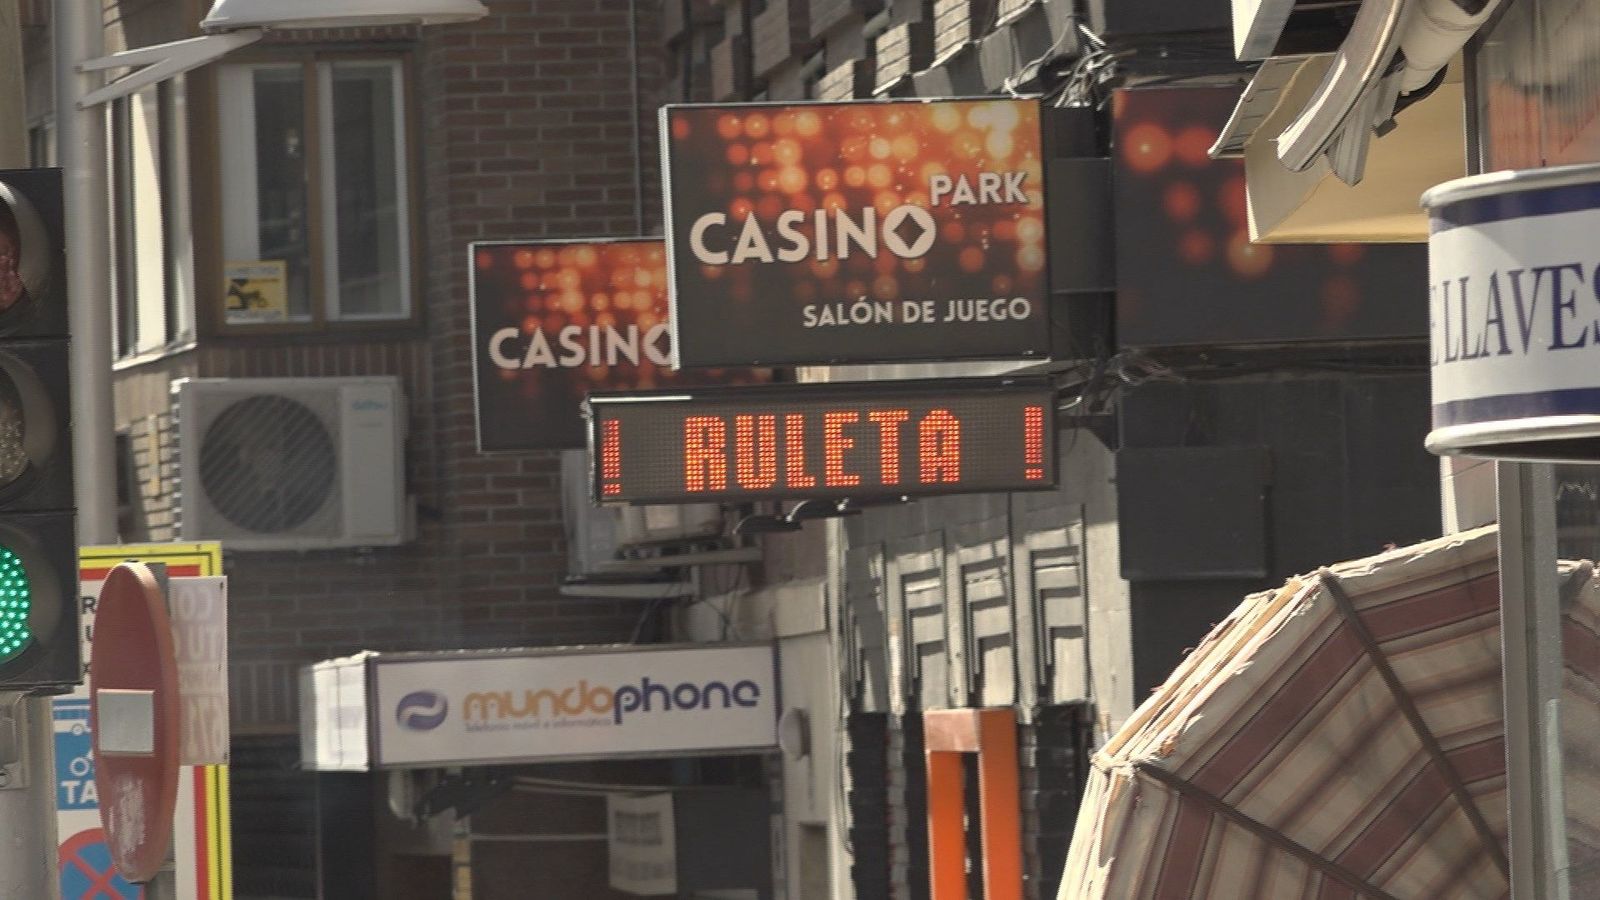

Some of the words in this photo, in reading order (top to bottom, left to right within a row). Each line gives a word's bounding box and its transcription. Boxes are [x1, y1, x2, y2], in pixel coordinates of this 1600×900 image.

[928, 172, 1029, 206] PARK
[690, 205, 936, 264] CASINO
[803, 296, 893, 328] SALÓN
[902, 301, 935, 323] DE
[943, 297, 1031, 322] JUEGO
[685, 408, 960, 492] RULETA
[462, 677, 760, 725] mundophone
